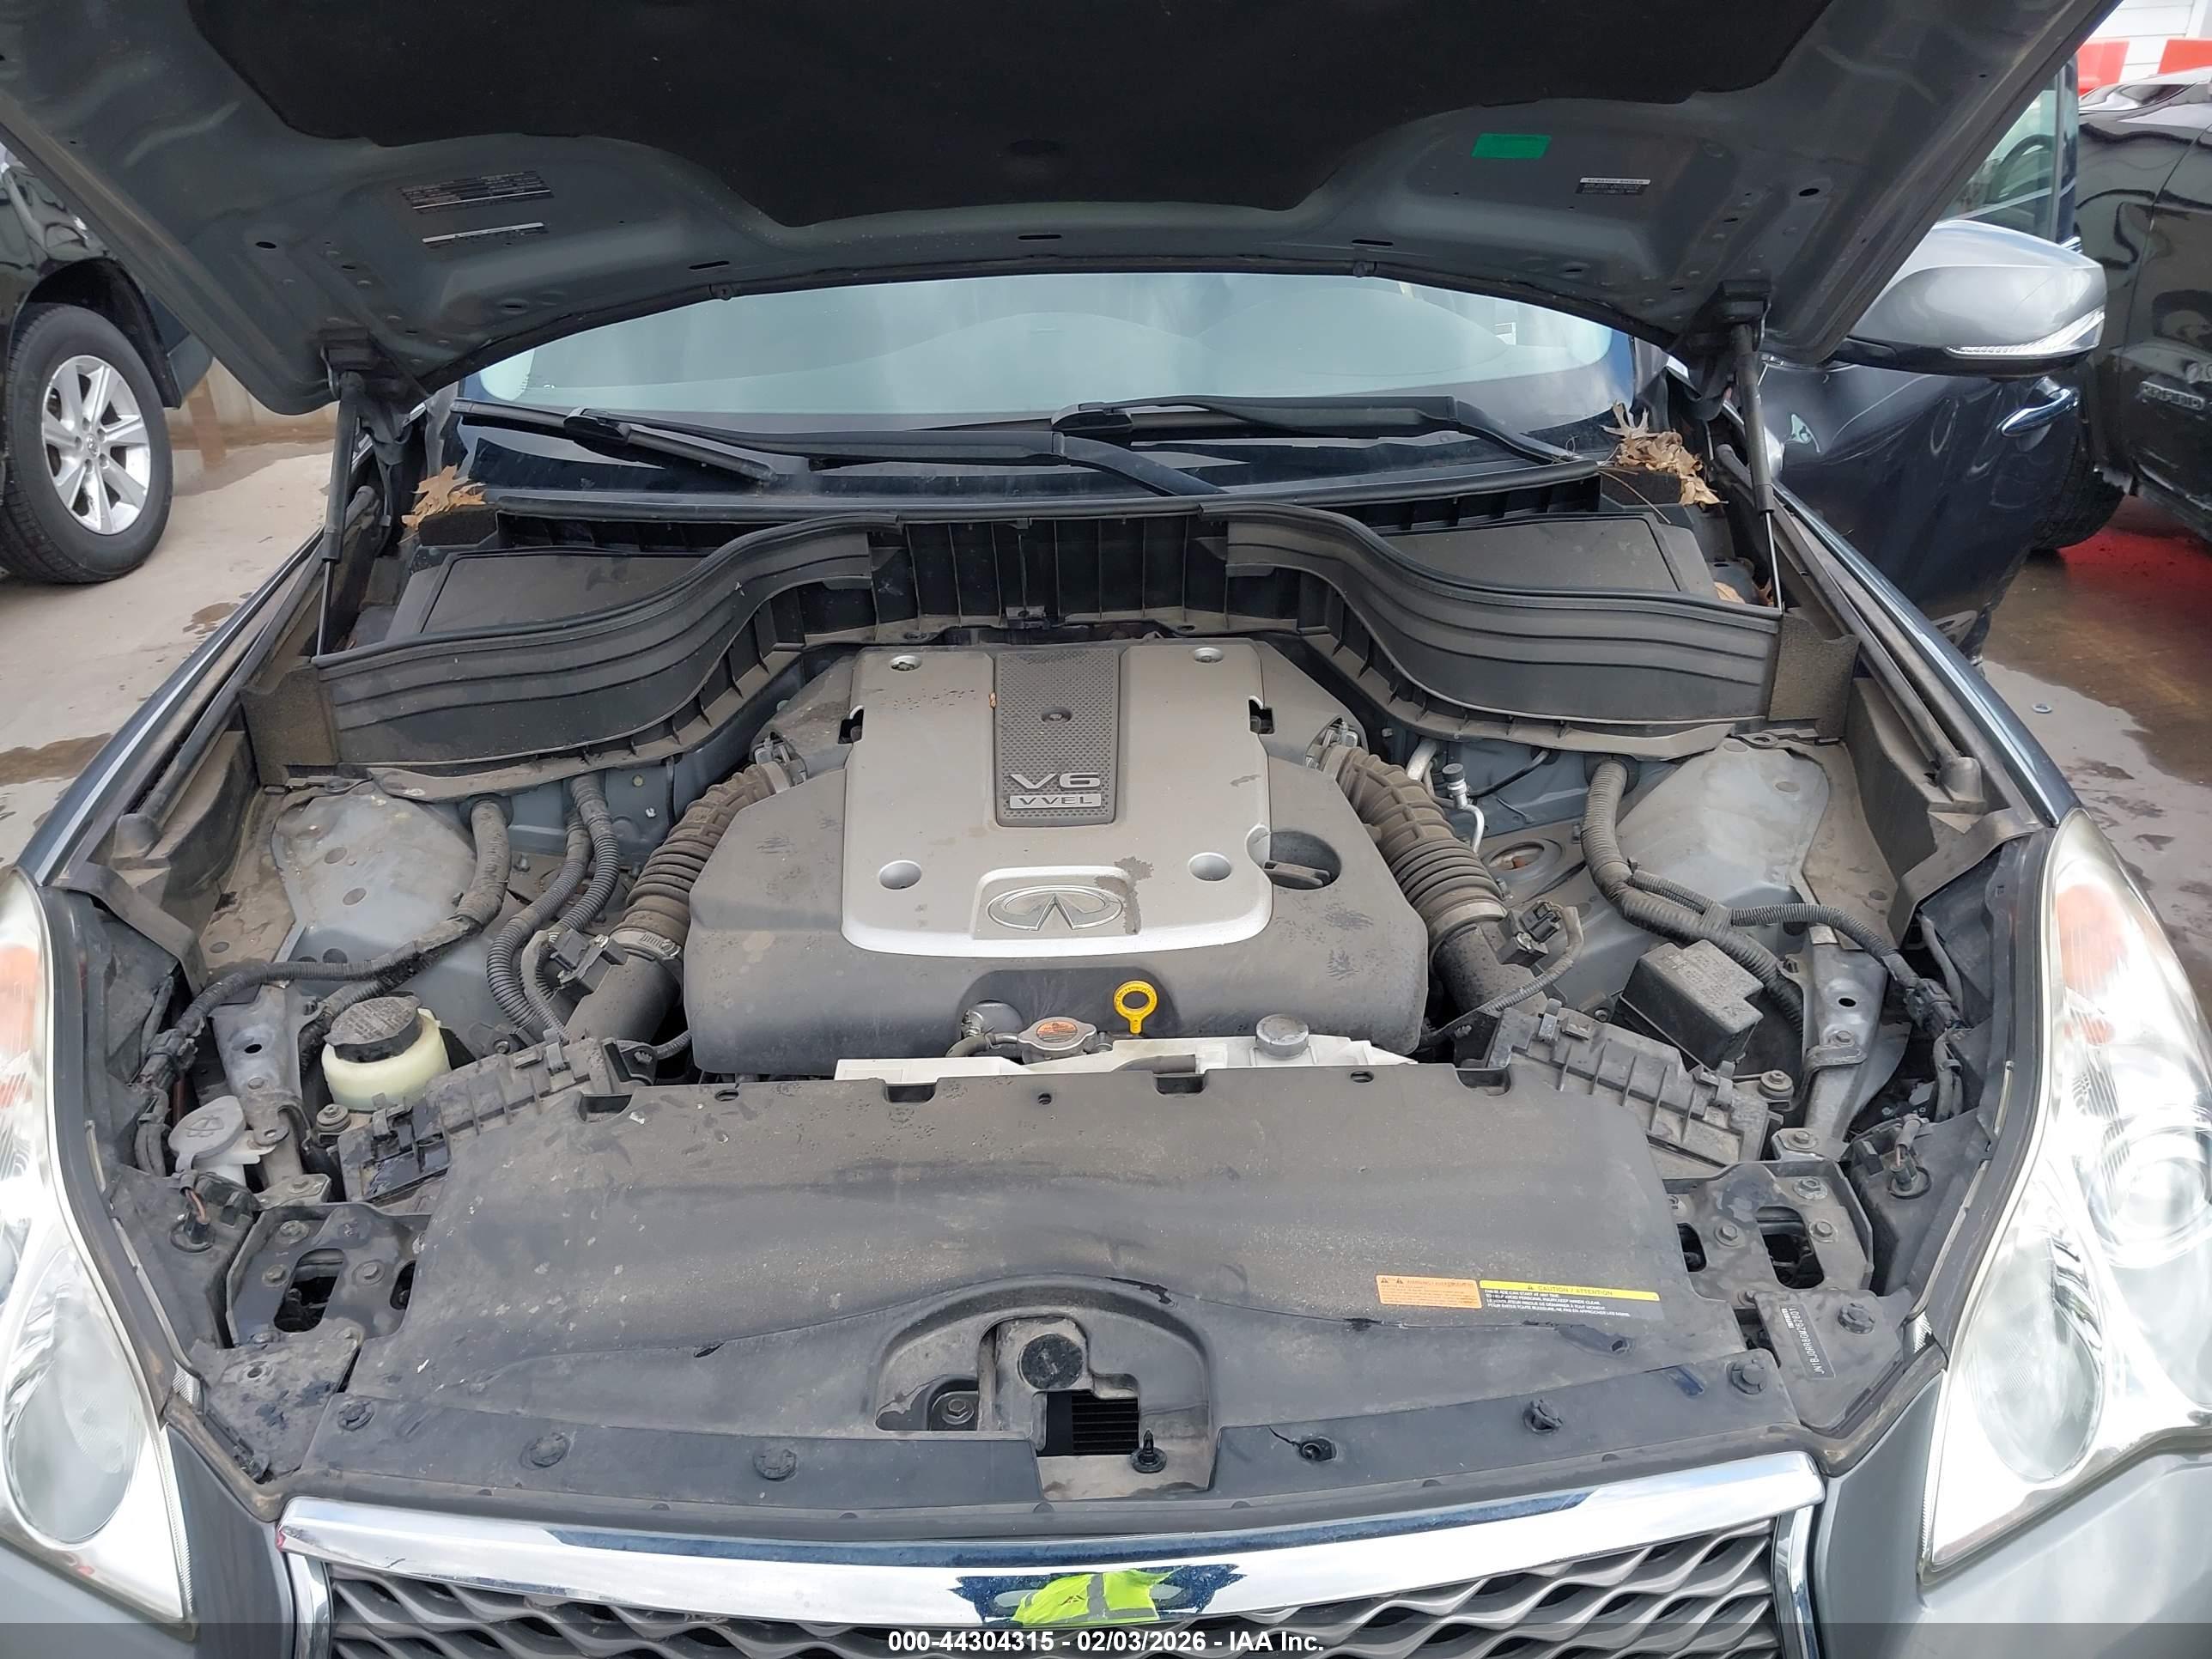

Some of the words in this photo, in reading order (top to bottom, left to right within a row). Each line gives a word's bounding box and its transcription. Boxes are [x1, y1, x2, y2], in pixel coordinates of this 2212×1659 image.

[1009, 772, 1101, 789] V6
[1018, 796, 1093, 805] VVEL
[1575, 1287, 1613, 1296] ATTENTION
